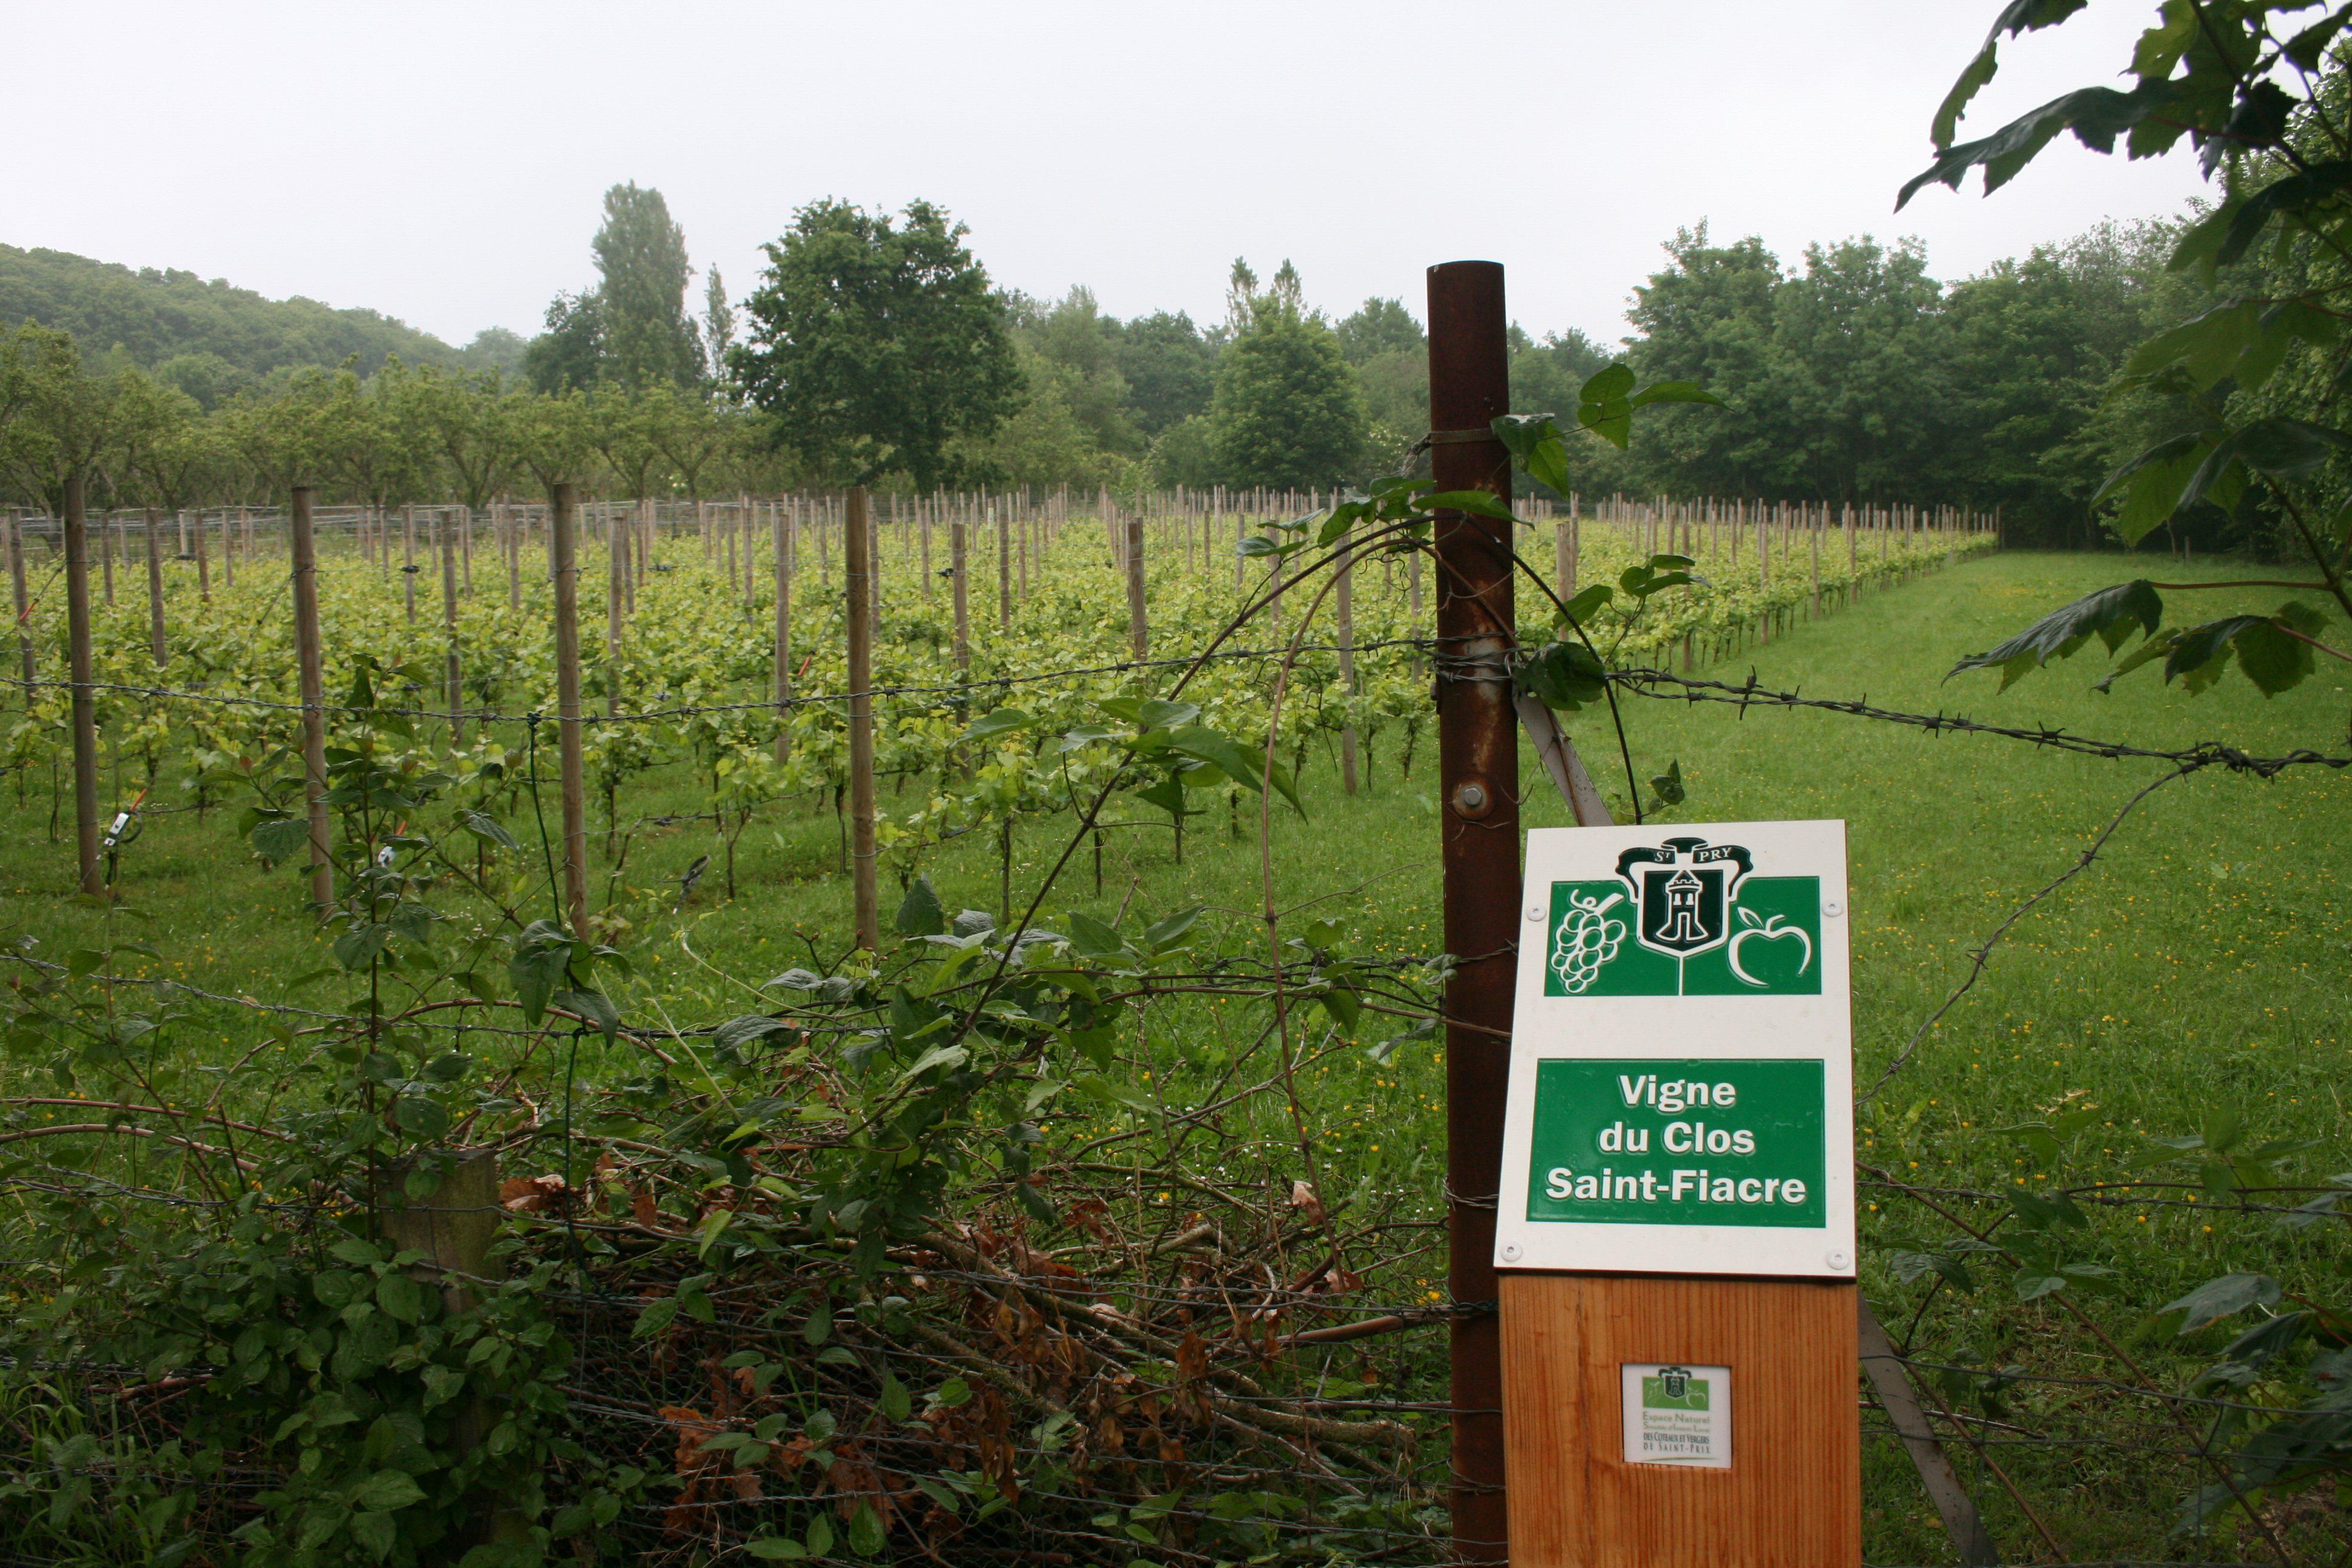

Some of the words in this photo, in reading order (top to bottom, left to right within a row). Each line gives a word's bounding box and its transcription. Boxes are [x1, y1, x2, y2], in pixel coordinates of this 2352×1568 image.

[1699, 847, 1733, 862] PRY
[1618, 1075, 1737, 1112] Vigne
[1599, 1122, 1648, 1153] du
[1664, 1122, 1756, 1154] Clos
[1546, 1168, 1807, 1203] Saint-Fiacre
[1643, 1411, 1673, 1423] Espace
[1675, 1413, 1710, 1423] Naturel
[1680, 1434, 1686, 1443] ET
[1687, 1434, 1710, 1444] VERGERS
[1659, 1443, 1710, 1453] SAINT-PRIX
